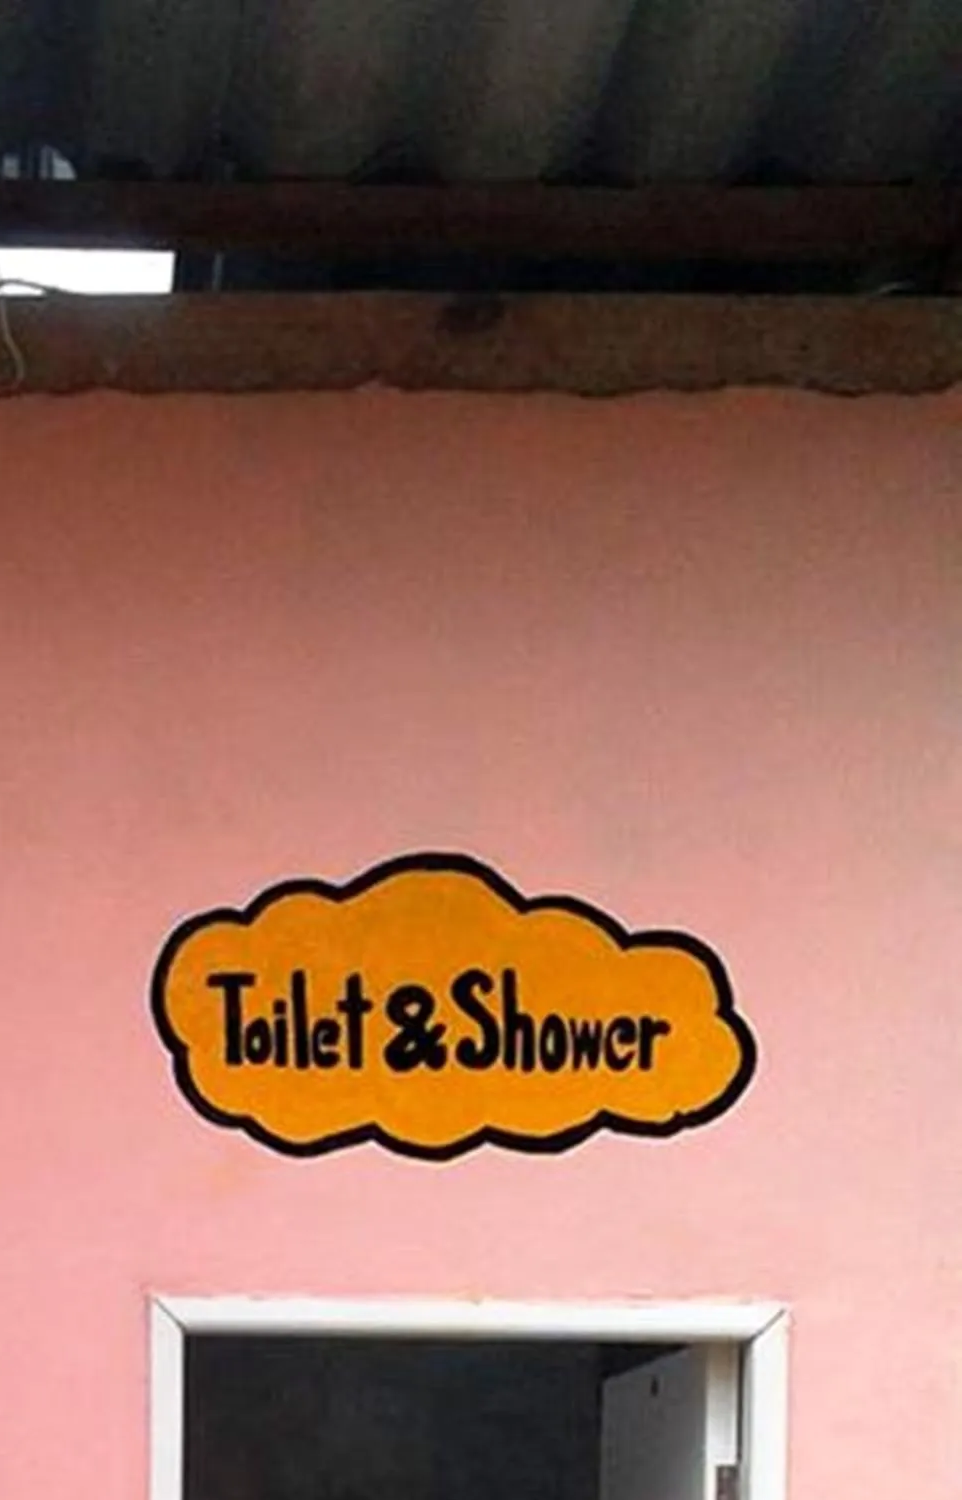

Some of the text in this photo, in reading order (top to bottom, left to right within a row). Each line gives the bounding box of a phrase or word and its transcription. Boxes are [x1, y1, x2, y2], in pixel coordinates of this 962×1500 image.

[206, 968, 671, 1072] Toilet & Shower
